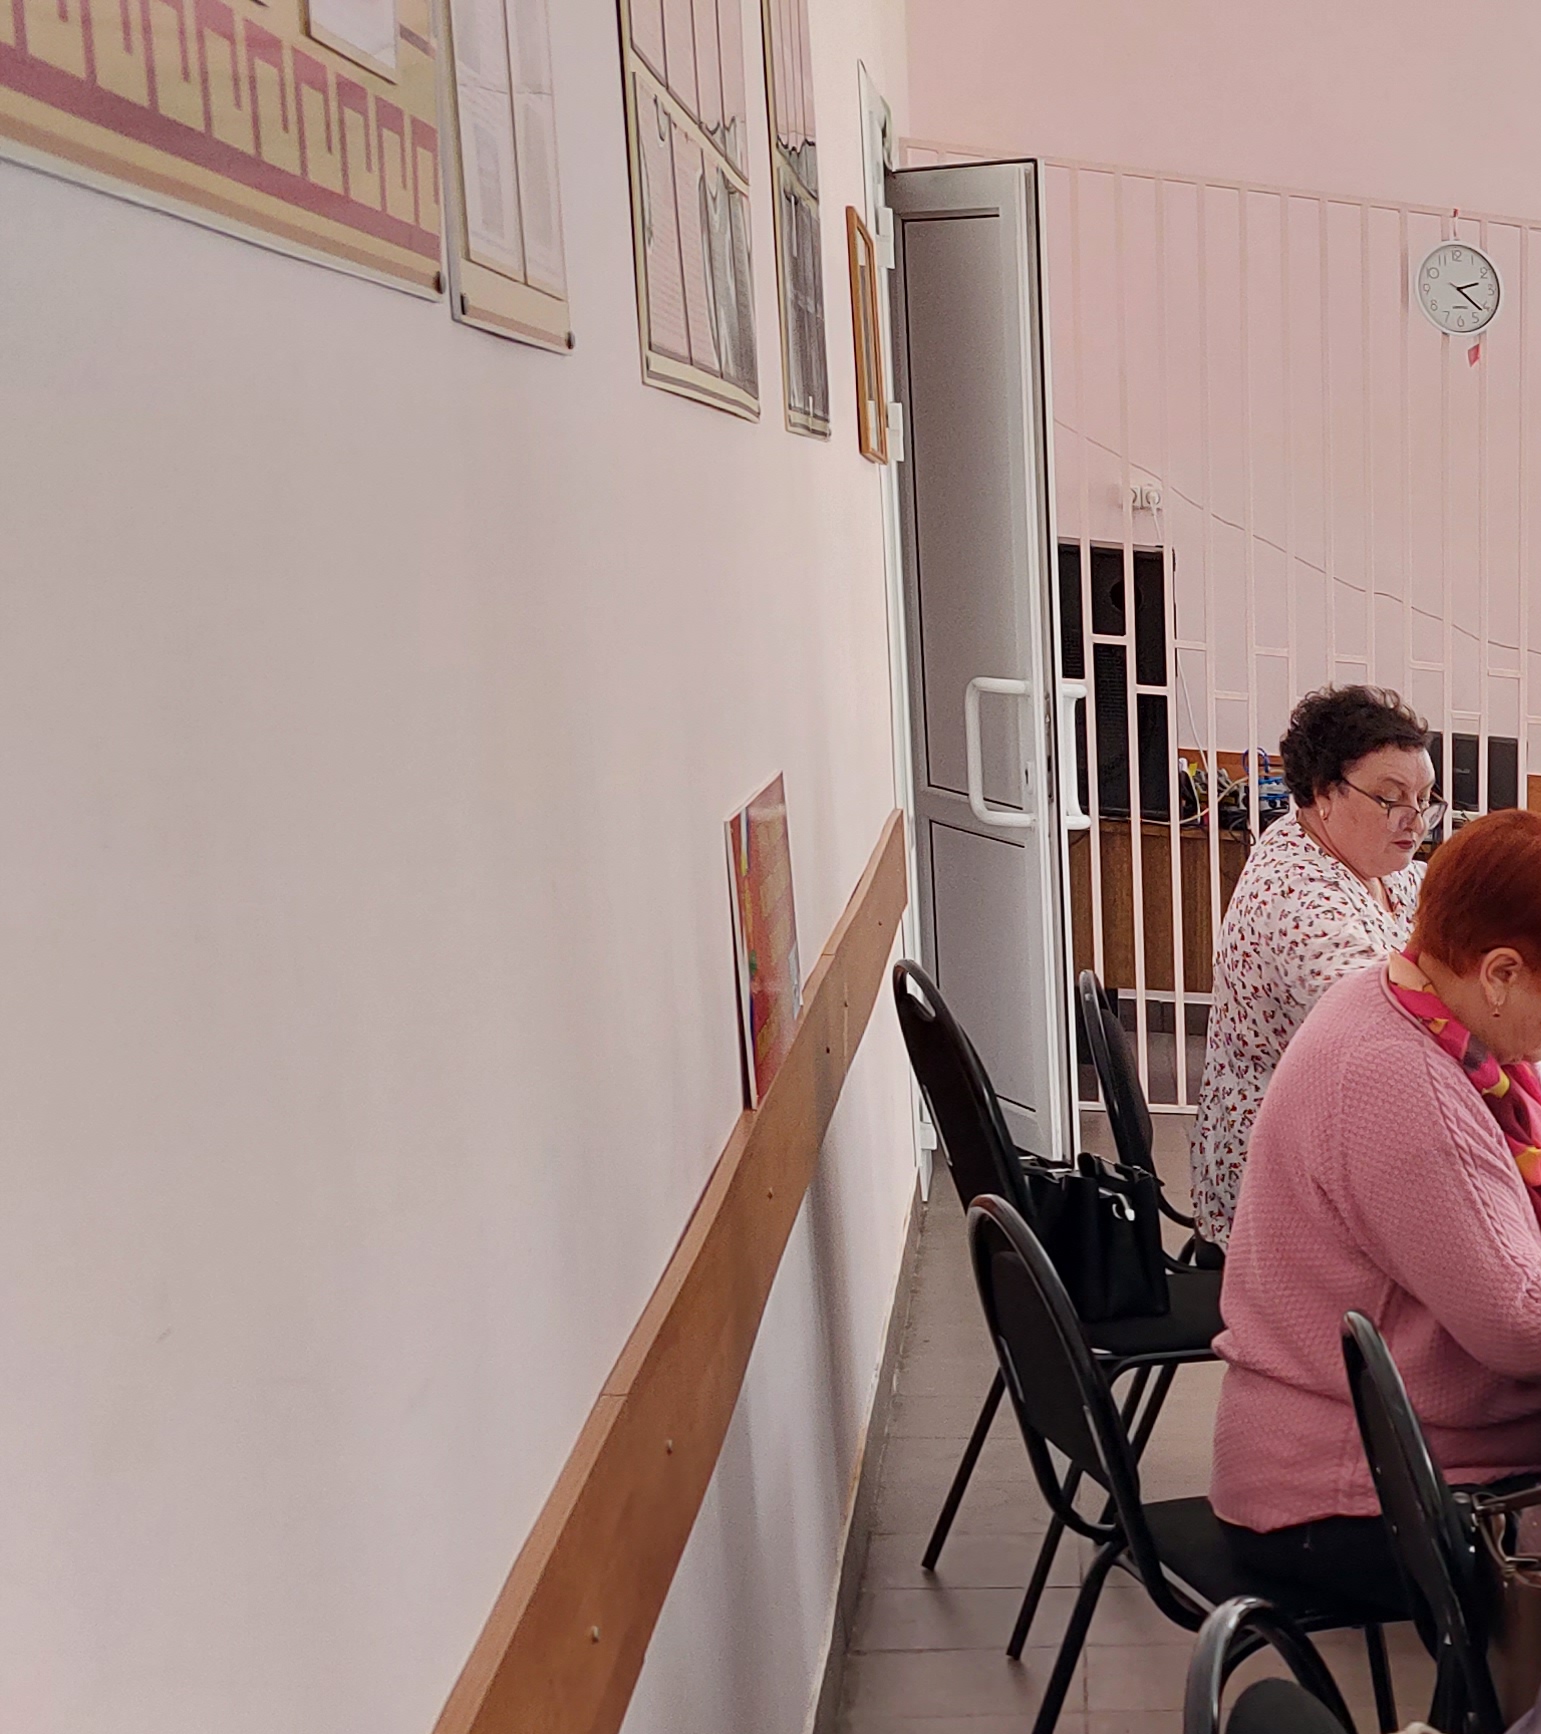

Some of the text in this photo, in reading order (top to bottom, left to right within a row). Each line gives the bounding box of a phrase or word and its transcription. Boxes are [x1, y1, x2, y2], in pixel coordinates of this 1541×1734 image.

[1452, 250, 1462, 262] 12
[1426, 267, 1488, 279] 10 2
[1423, 284, 1495, 296] 9 3
[1442, 311, 1480, 327] 7 6 5
